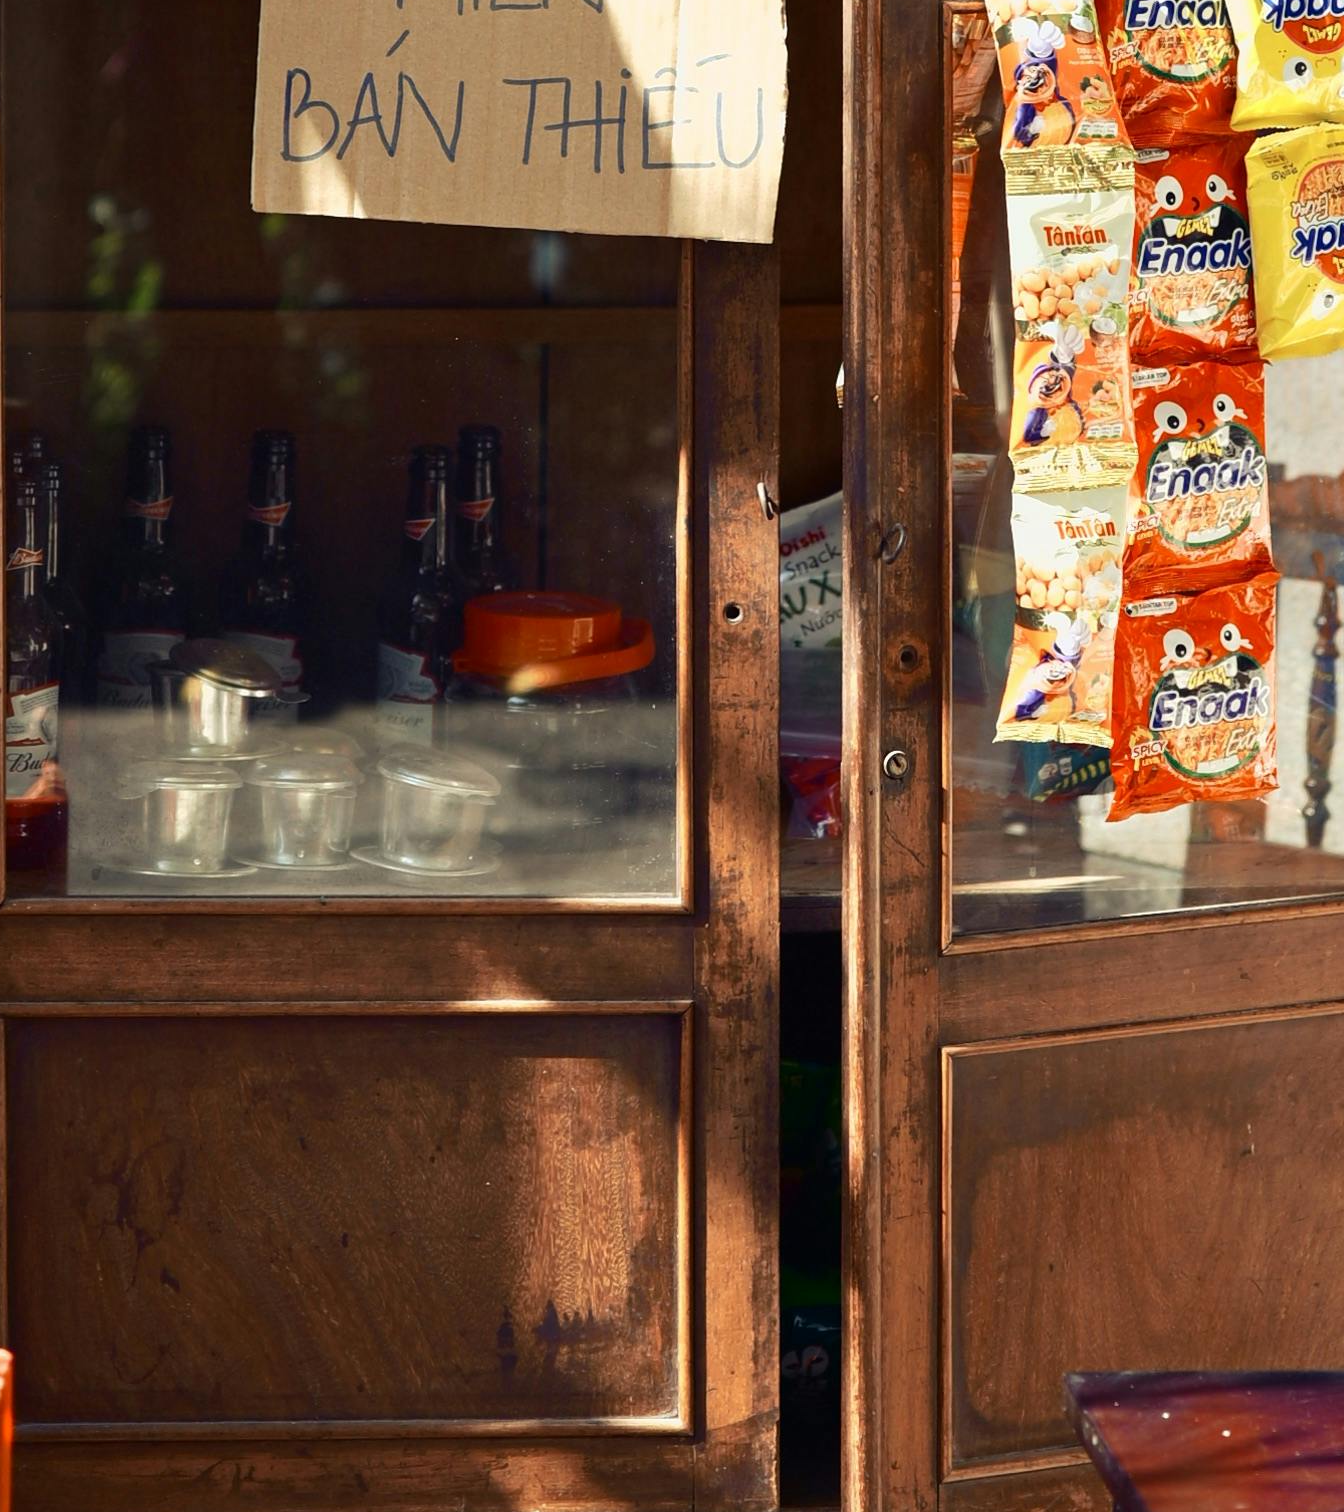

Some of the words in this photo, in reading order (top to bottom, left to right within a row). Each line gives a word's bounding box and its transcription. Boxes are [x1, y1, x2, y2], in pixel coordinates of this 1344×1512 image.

[279, 29, 465, 165] BÁN
[1175, 217, 1215, 239] GEMEZ
[1136, 228, 1252, 277] Enaak
[1207, 279, 1249, 306] Extra
[1147, 446, 1266, 504] Enaak
[780, 526, 827, 558] Oishi
[784, 542, 842, 581] Snack
[1148, 677, 1270, 732] Enaak
[1131, 739, 1168, 760] SPICY
